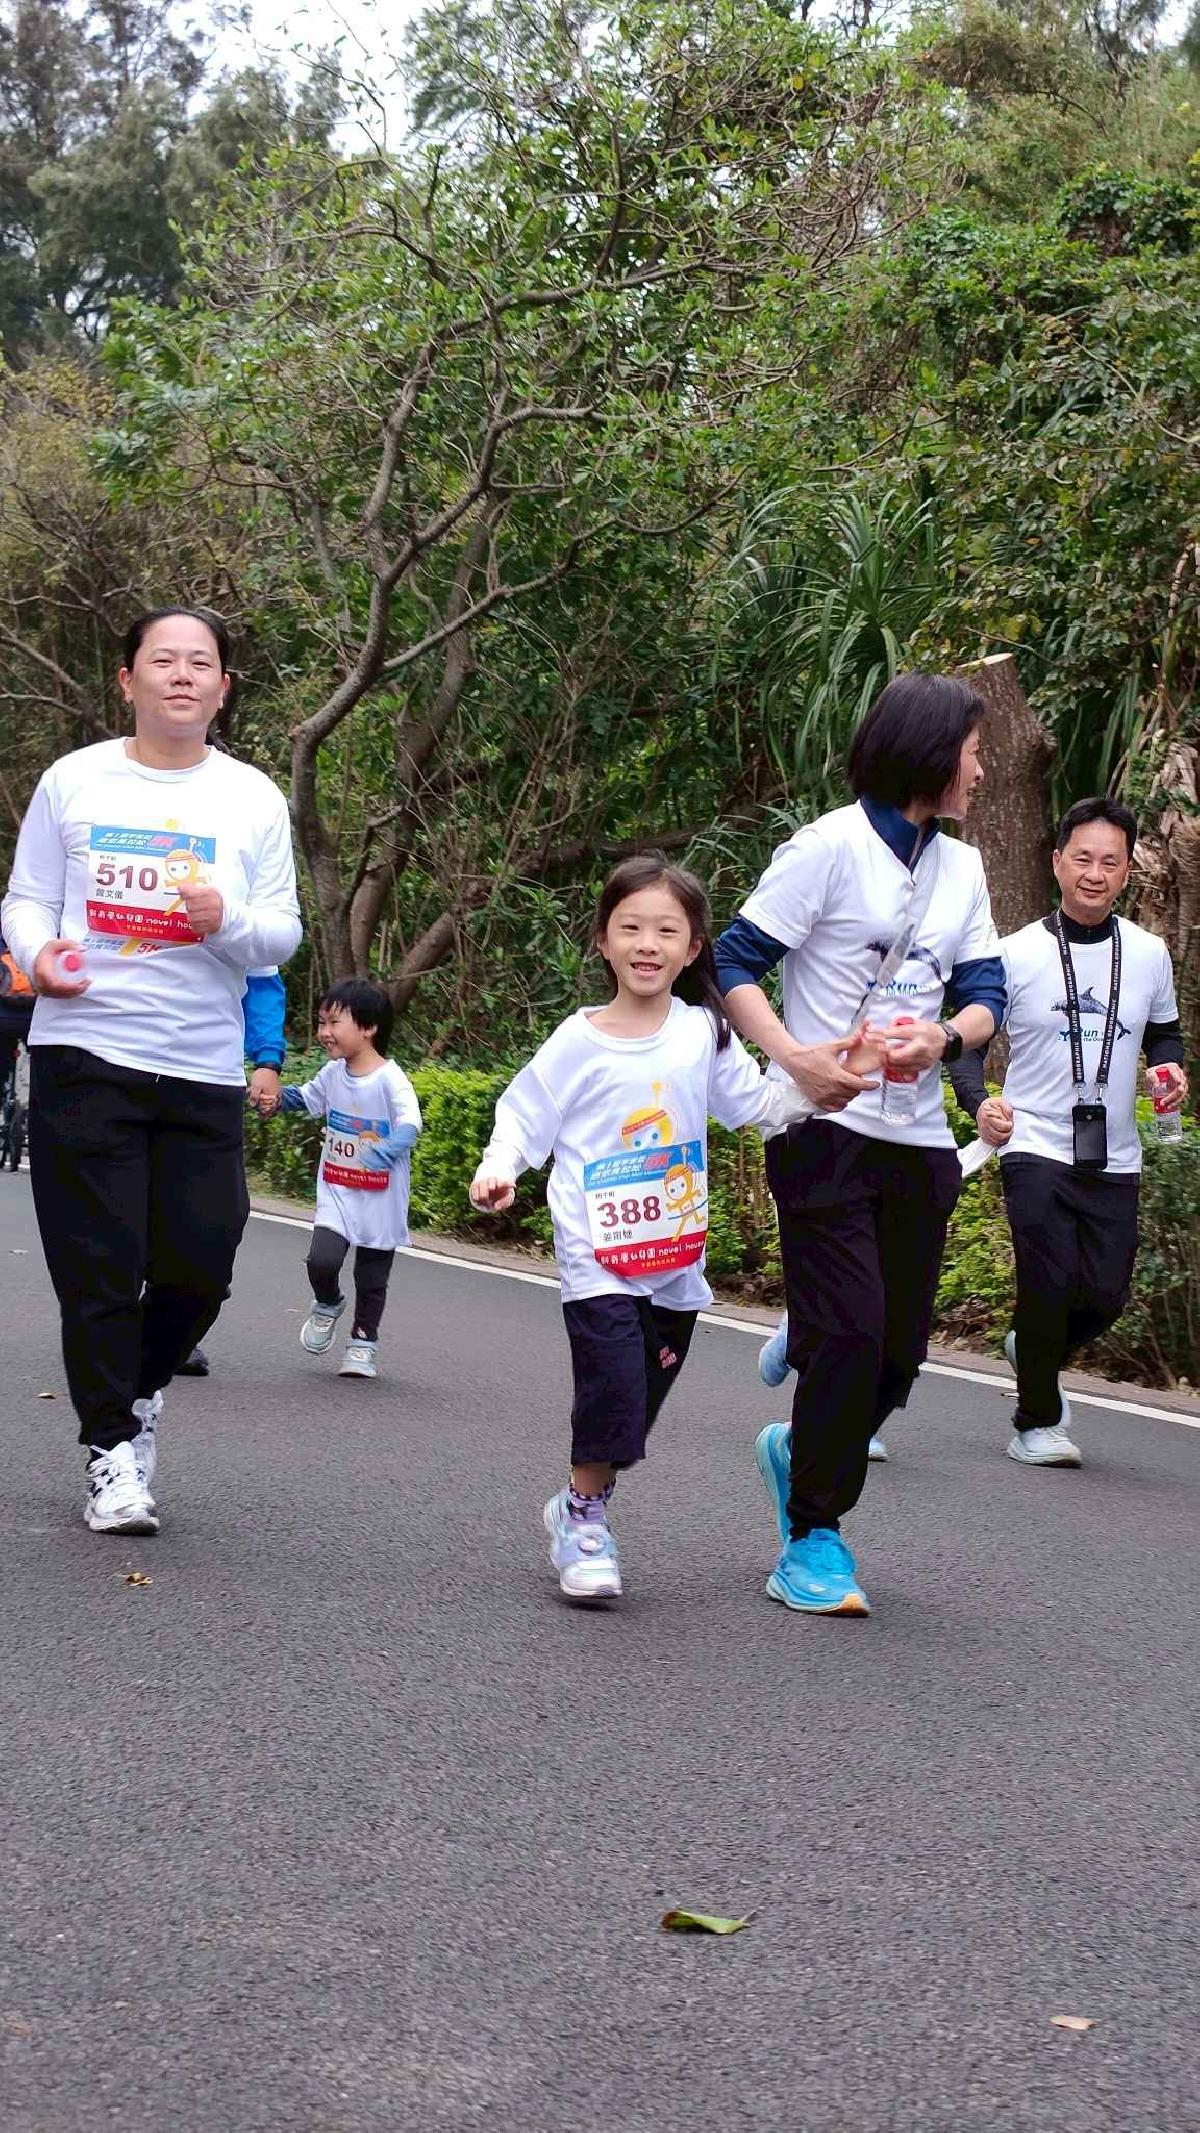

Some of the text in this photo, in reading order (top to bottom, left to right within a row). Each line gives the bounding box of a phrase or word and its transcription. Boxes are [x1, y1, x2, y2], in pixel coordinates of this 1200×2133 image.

[96, 863, 158, 891] 510
[328, 1136, 355, 1158] 140
[597, 1196, 661, 1227] 388
[658, 1244, 682, 1257] novel
